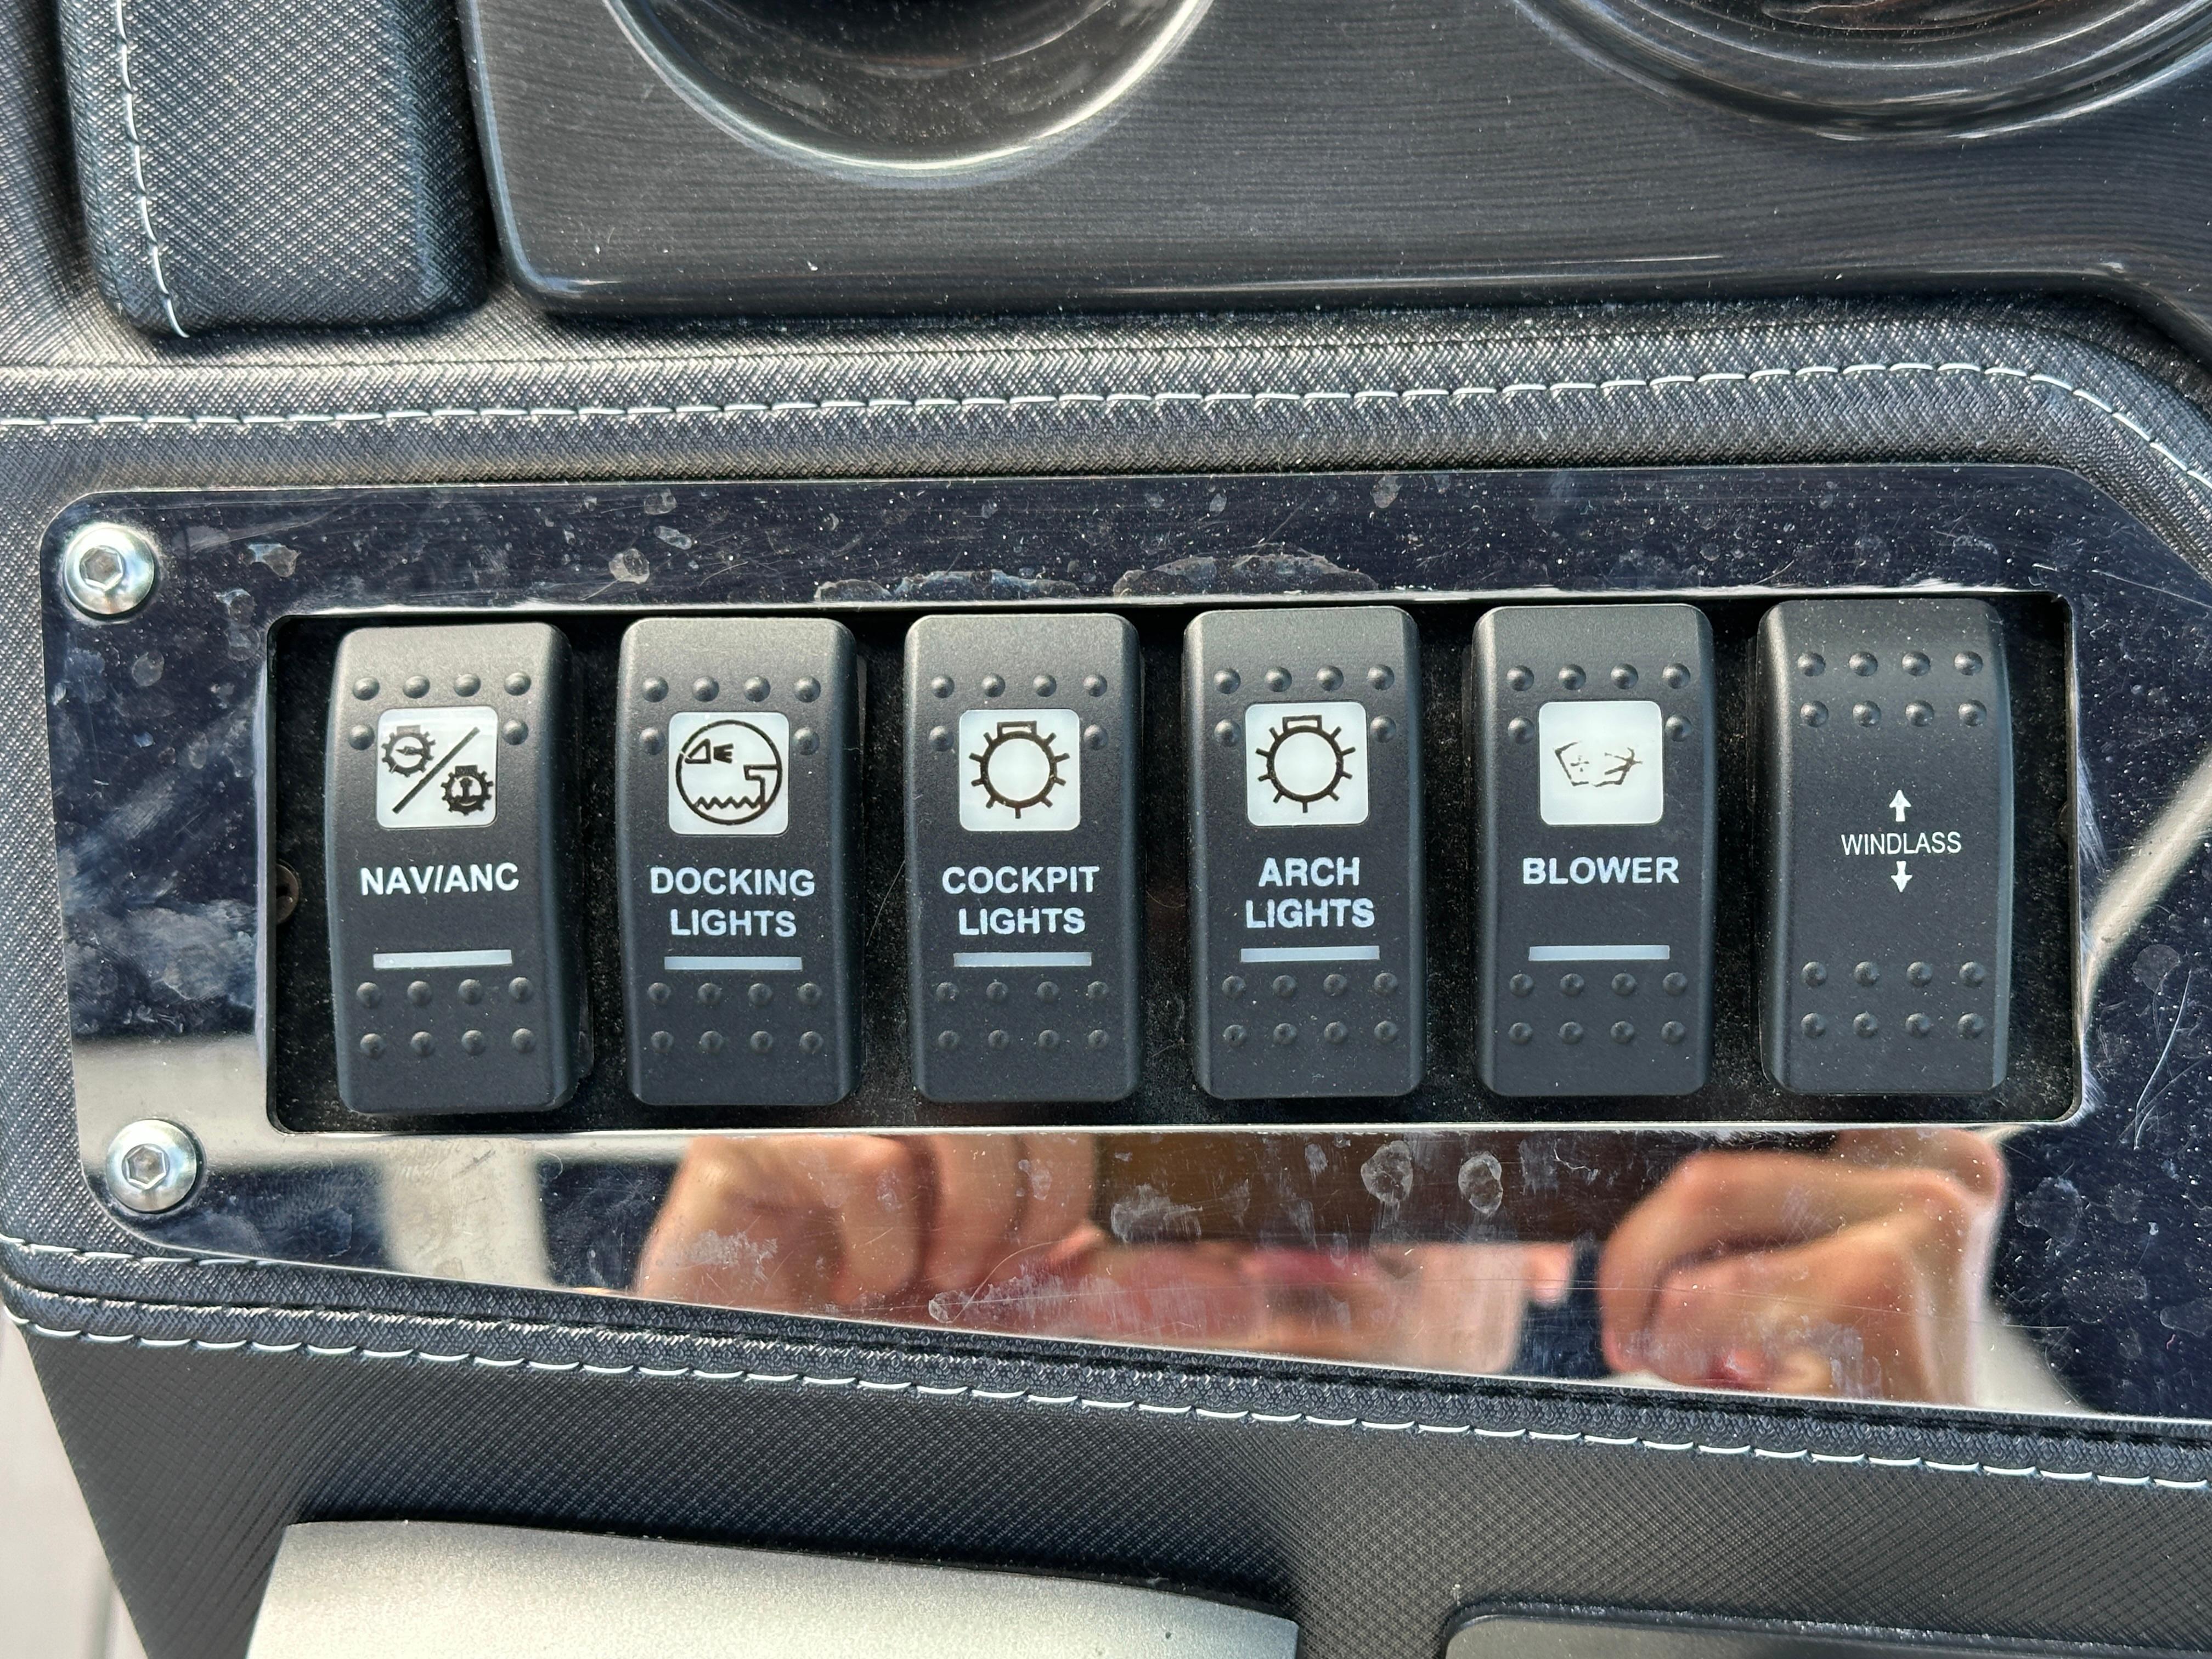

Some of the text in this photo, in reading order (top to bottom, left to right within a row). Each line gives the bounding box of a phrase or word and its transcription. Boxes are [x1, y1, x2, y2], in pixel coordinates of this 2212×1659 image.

[1841, 832, 1962, 855] WINDLASS
[360, 862, 520, 895] NAV/ANC
[650, 867, 816, 896] DOCKING
[942, 866, 1099, 894] COCKPIT
[1258, 857, 1360, 887] ARCH
[1522, 856, 1680, 885] BLOWER
[670, 909, 797, 938] LIGHTS
[958, 907, 1086, 935] LIGHTS
[1245, 898, 1375, 928] LIGHTS
